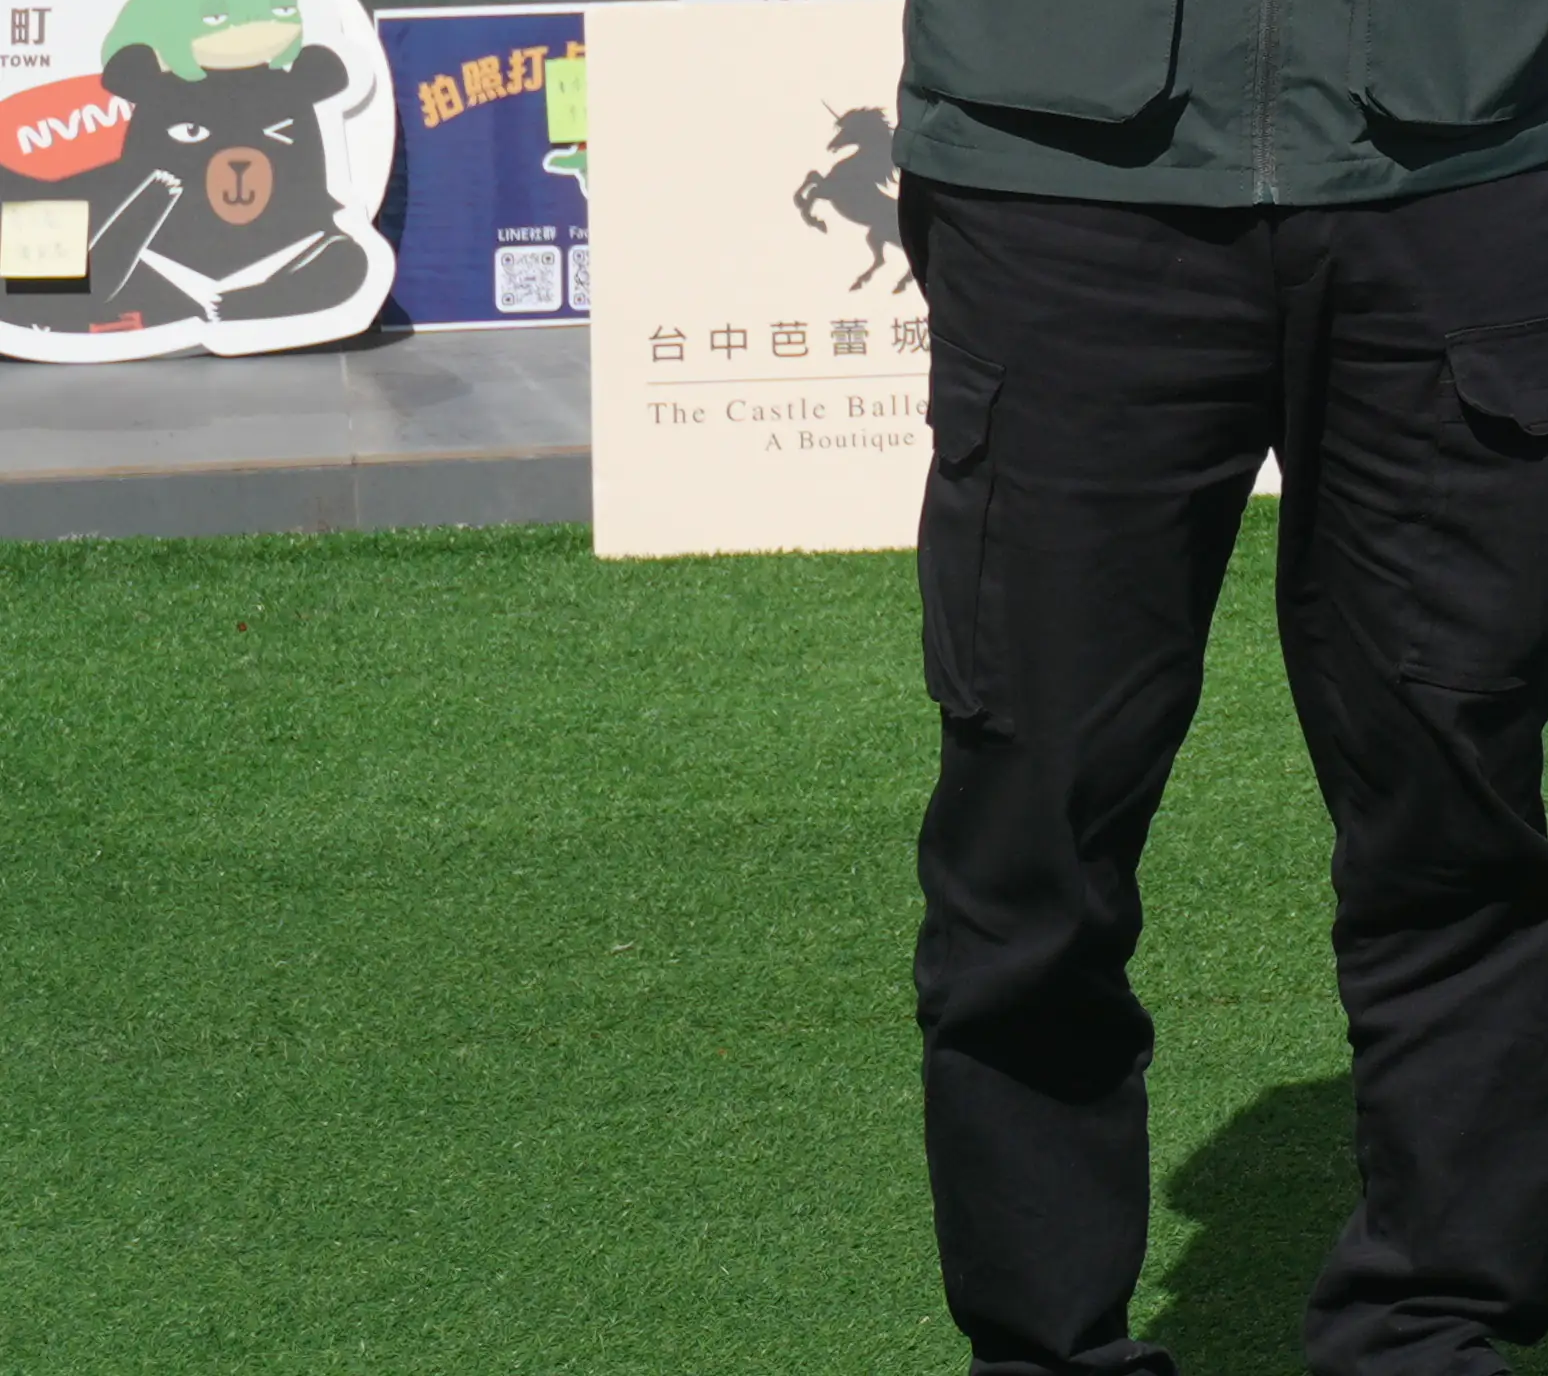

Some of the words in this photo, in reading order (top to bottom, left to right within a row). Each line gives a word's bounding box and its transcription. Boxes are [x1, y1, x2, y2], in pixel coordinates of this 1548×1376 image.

[0, 54, 51, 68] TOWN
[648, 317, 931, 363] 台中芭蕾城
[647, 402, 705, 424] The
[726, 398, 826, 423] Castle
[765, 432, 782, 451] A
[799, 428, 916, 452] Boutique
